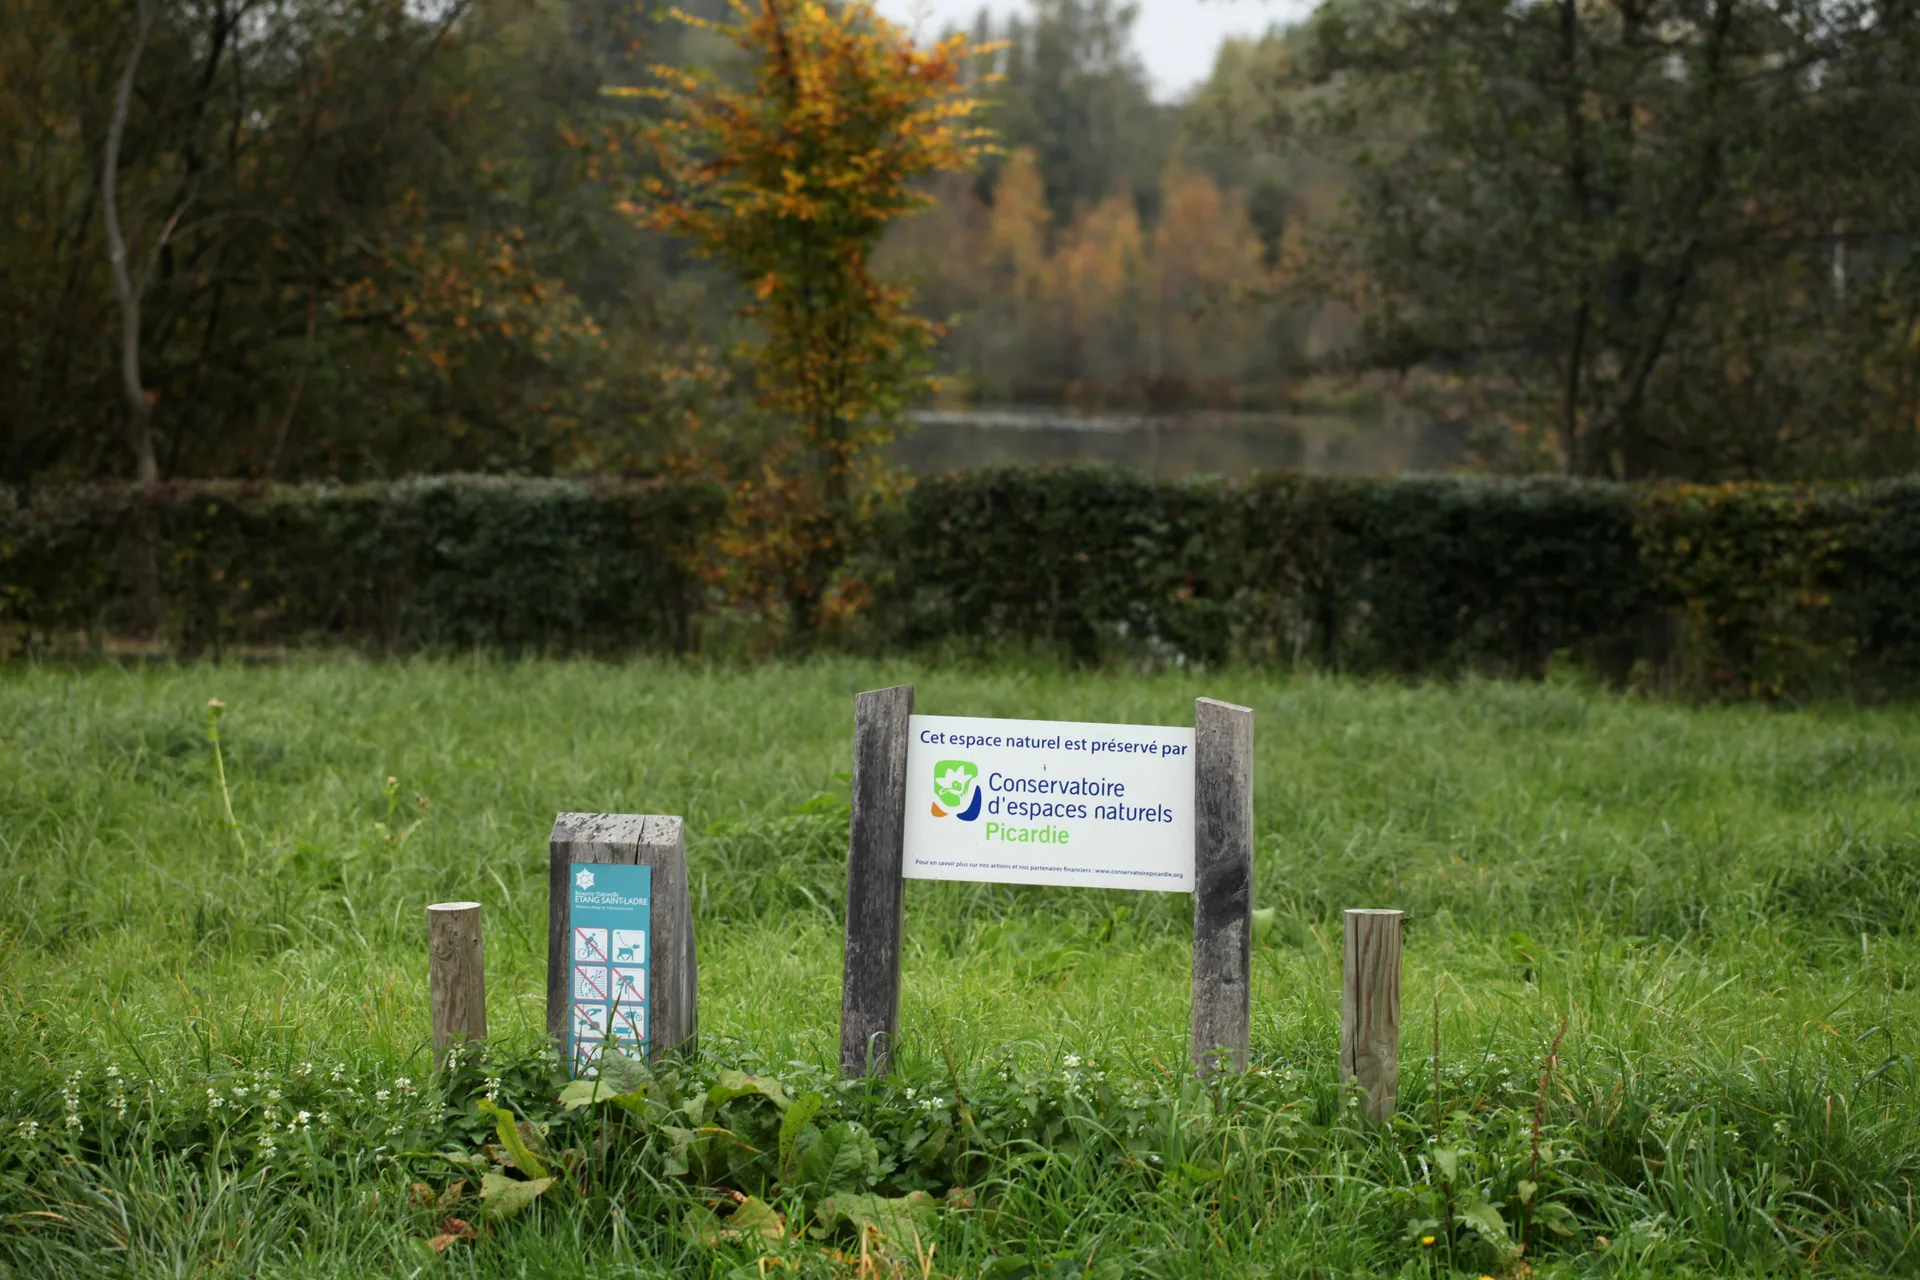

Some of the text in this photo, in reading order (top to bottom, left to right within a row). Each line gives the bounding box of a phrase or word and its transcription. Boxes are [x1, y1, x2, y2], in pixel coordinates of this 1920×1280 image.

[920, 730, 1188, 757] Cet espace naturel est préservé par
[989, 772, 1125, 797] Conservatoire
[988, 796, 1173, 823] d'espaces naturels
[986, 822, 1070, 844] Picardie
[990, 862, 1011, 870] actions
[1030, 865, 1062, 873] partenaires
[1095, 867, 1183, 879] www.conservatoirepicardie.org
